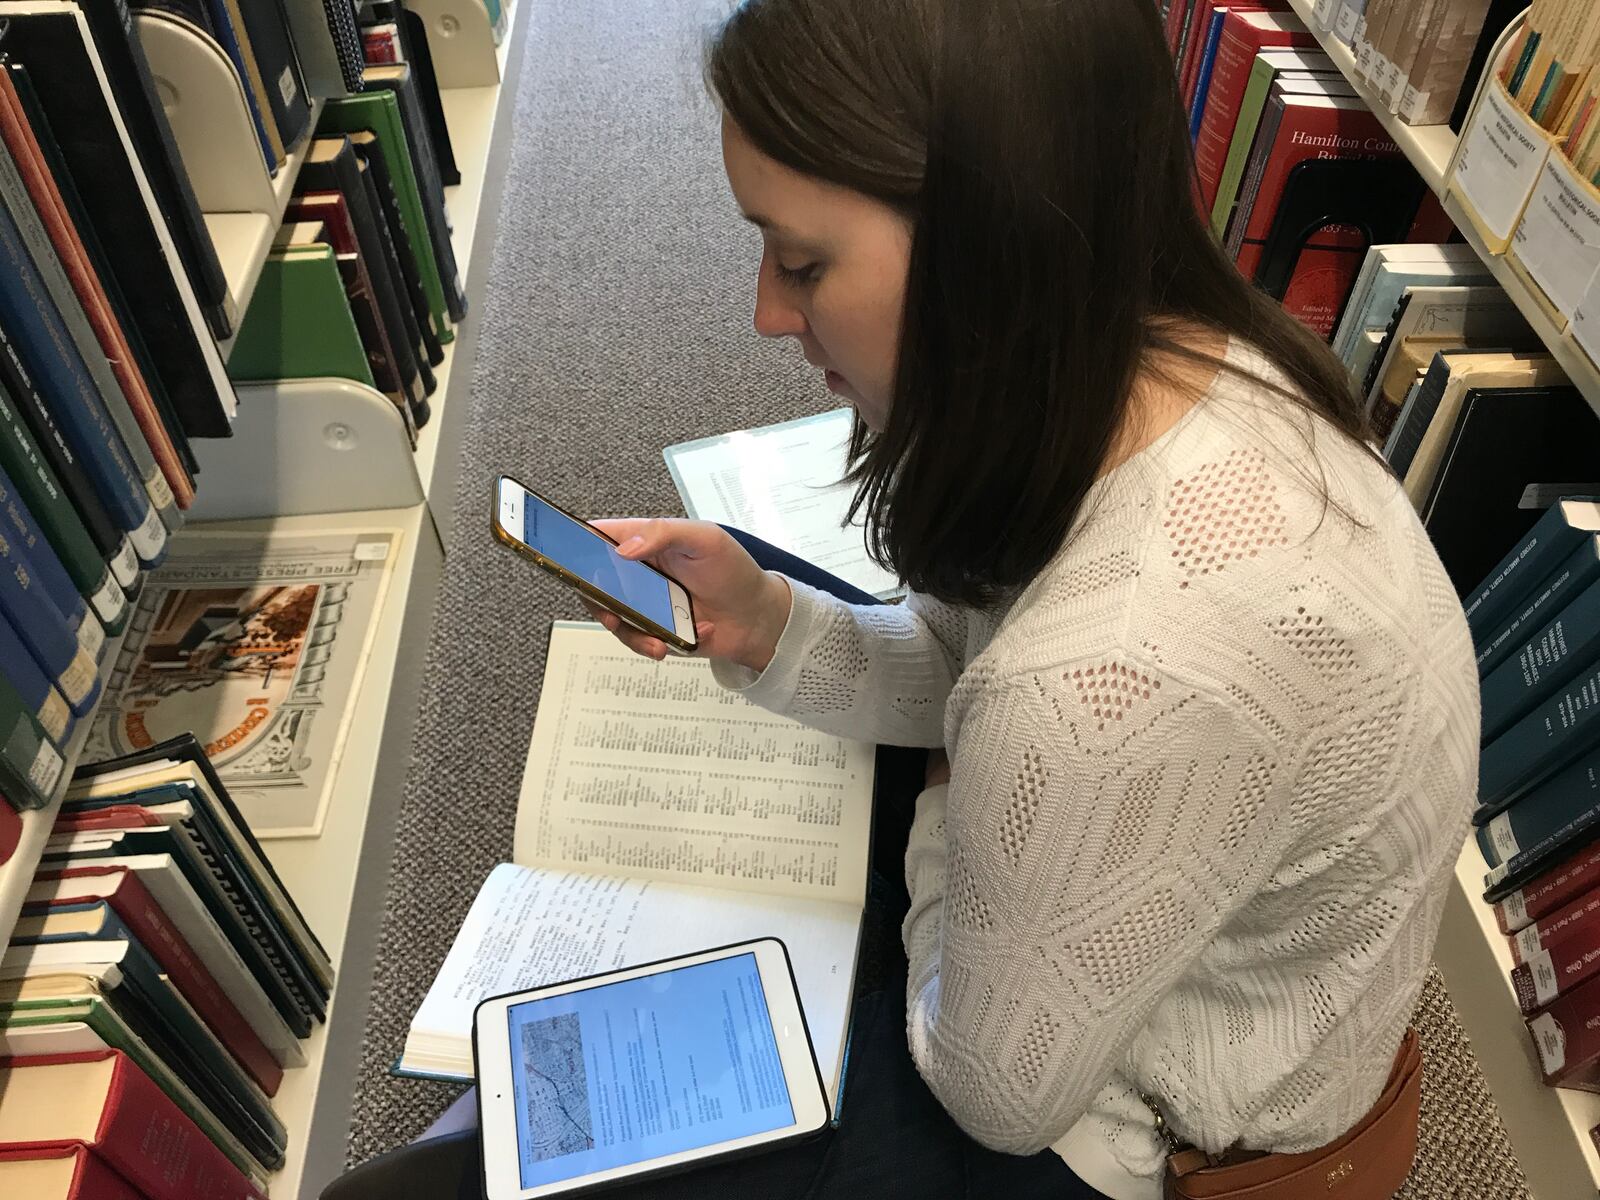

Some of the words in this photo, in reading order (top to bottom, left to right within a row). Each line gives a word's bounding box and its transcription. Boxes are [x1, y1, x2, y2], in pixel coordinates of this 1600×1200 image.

[1291, 130, 1360, 149] Hamilton
[1517, 132, 1536, 153] SOCIETY
[313, 564, 353, 574] FREE
[1546, 628, 1561, 661] HAMILTON
[1553, 621, 1568, 654] RESTORED
[1533, 649, 1544, 665] OHIO
[1586, 678, 1600, 703] HAMILTON
[1573, 696, 1582, 710] OHIO
